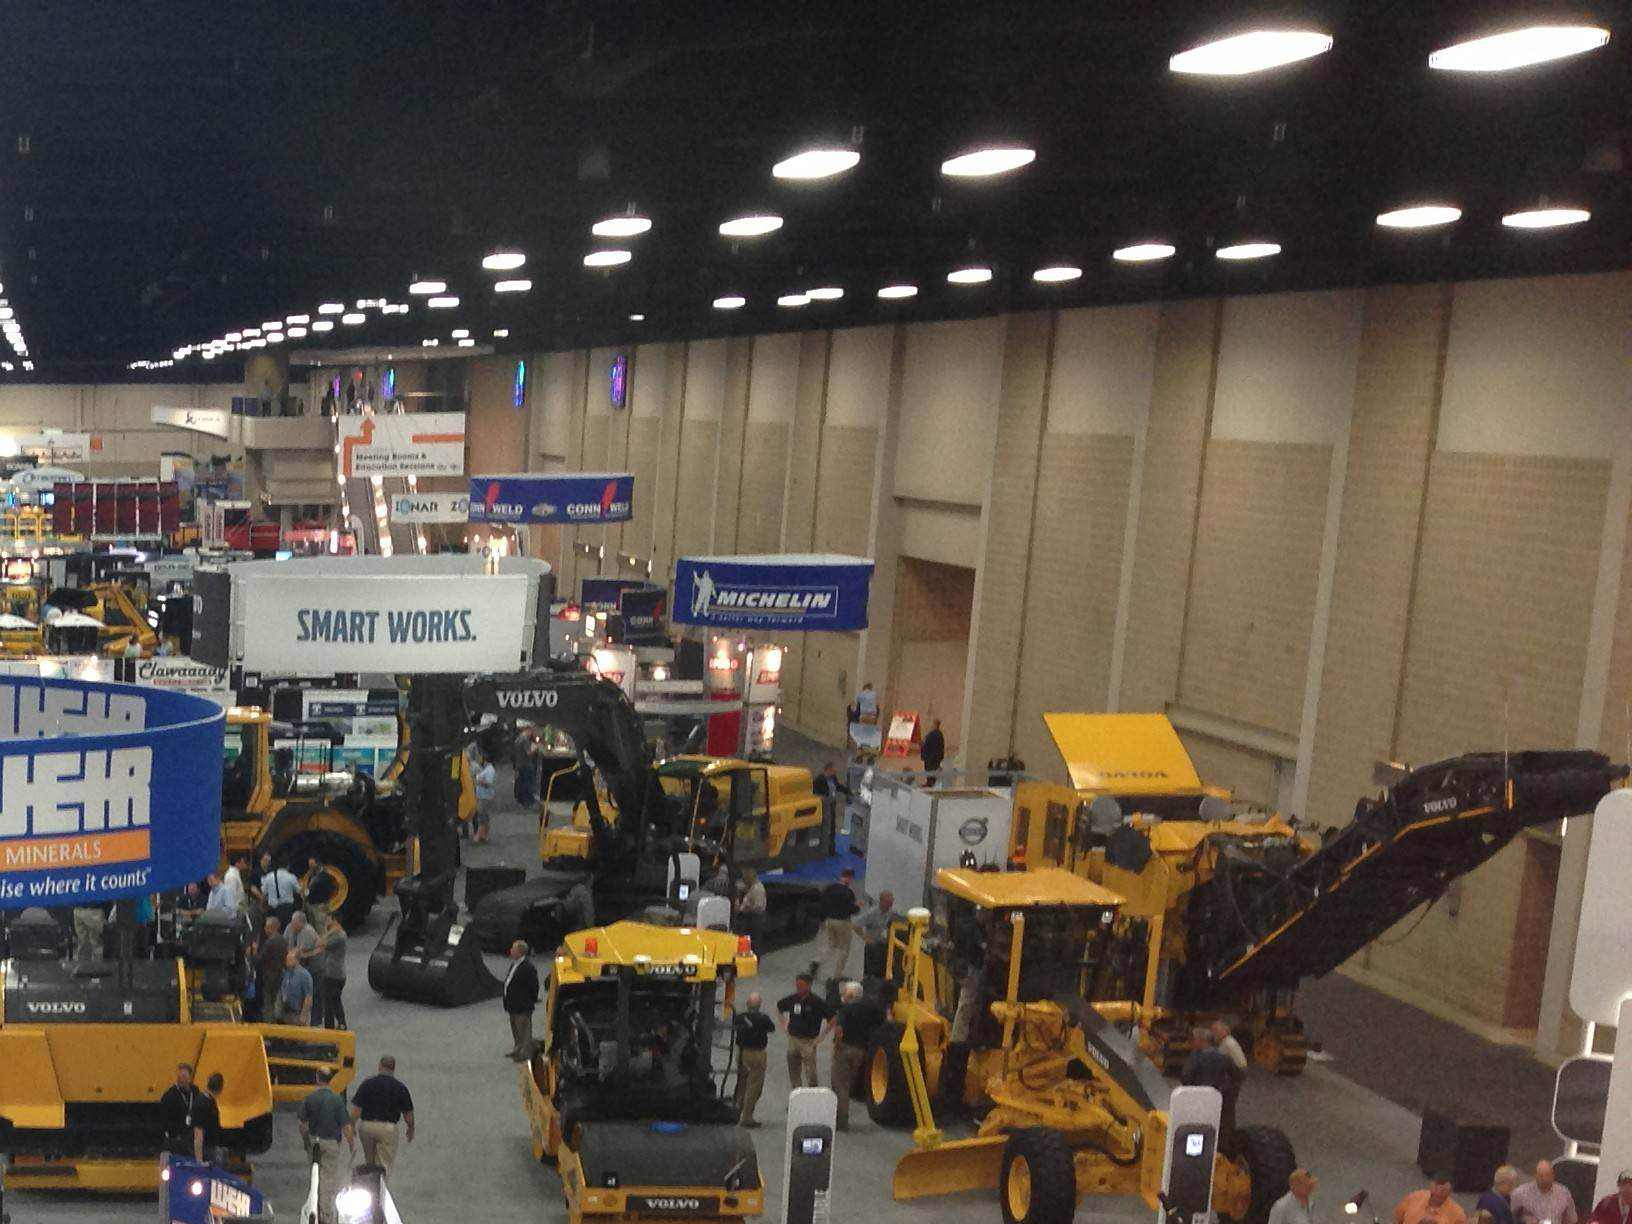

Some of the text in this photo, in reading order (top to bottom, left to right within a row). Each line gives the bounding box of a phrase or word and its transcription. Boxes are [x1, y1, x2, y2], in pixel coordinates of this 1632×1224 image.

[717, 590, 832, 609] MICHELIN
[297, 608, 477, 643] SMART WORKS.
[496, 690, 558, 708] VOLVO
[1423, 798, 1457, 814] VOLVO
[5, 841, 102, 865] MINERALS
[29, 876, 81, 898] where
[84, 873, 97, 892] it
[102, 869, 148, 890] counts
[26, 1001, 86, 1014] VOLVO
[646, 1197, 700, 1210] VOLVO
